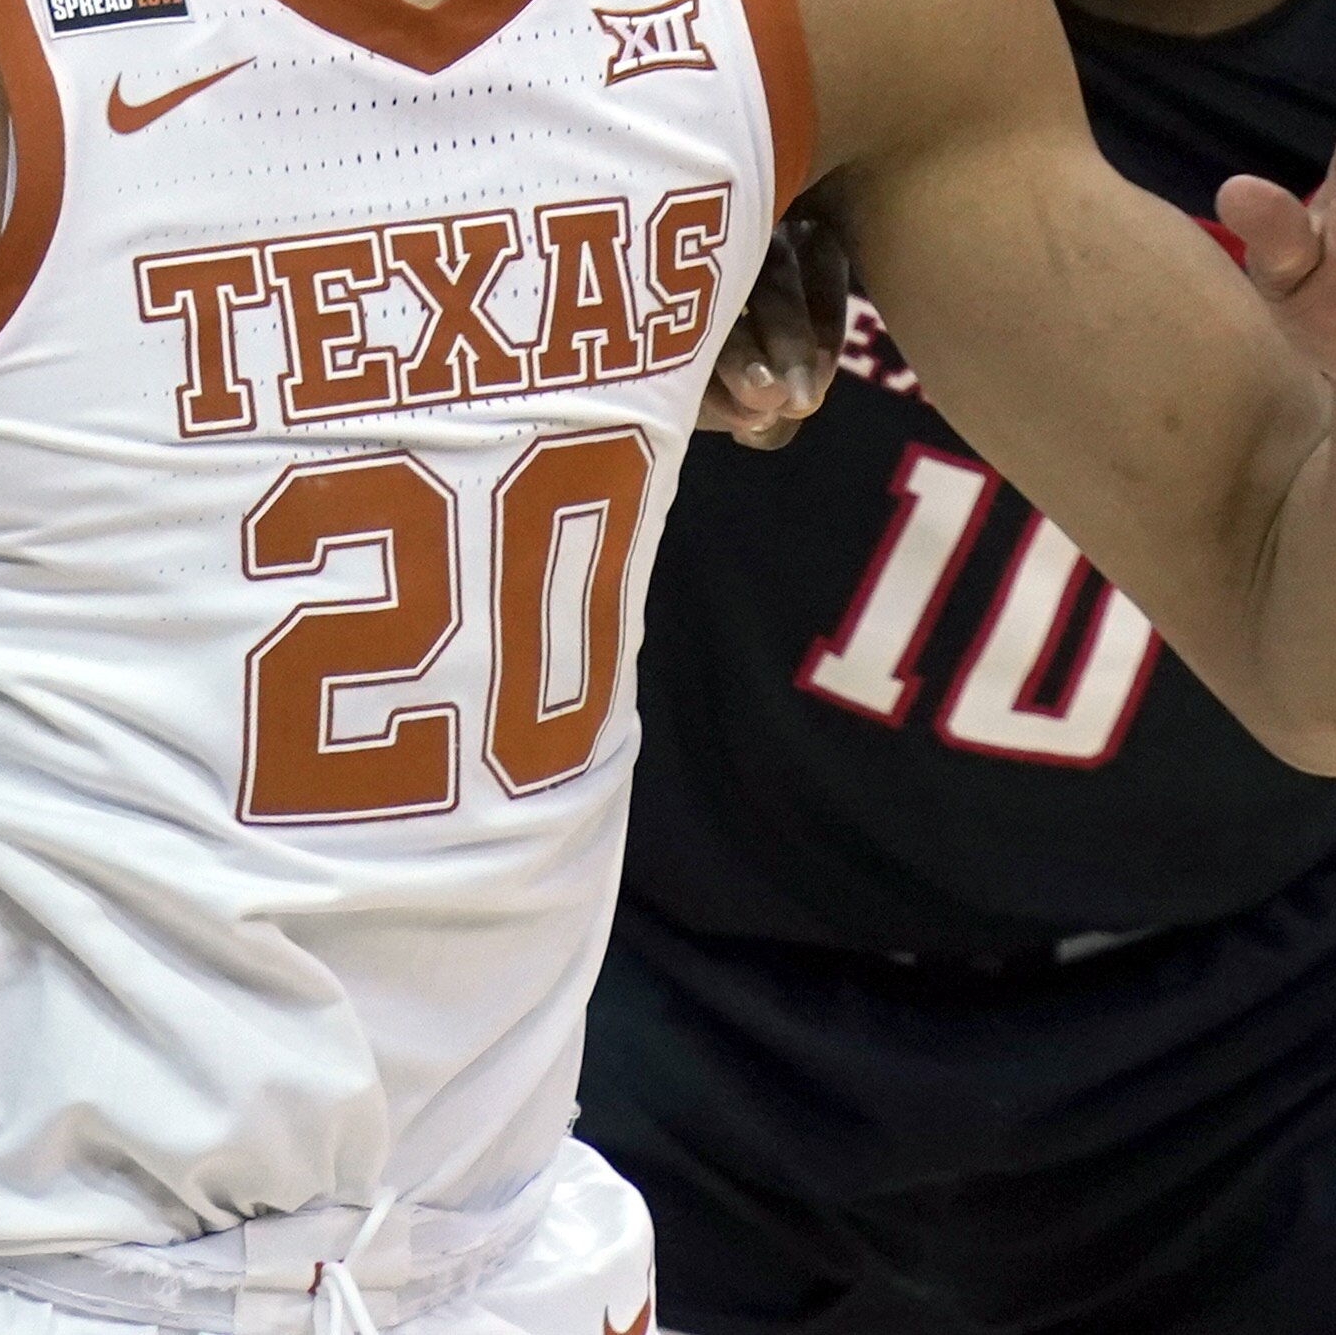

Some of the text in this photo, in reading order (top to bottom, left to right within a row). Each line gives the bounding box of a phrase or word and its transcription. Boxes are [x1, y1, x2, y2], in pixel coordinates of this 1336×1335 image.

[134, 183, 732, 439] TEXAS
[237, 424, 655, 826] 20
[794, 442, 1166, 769] 10
